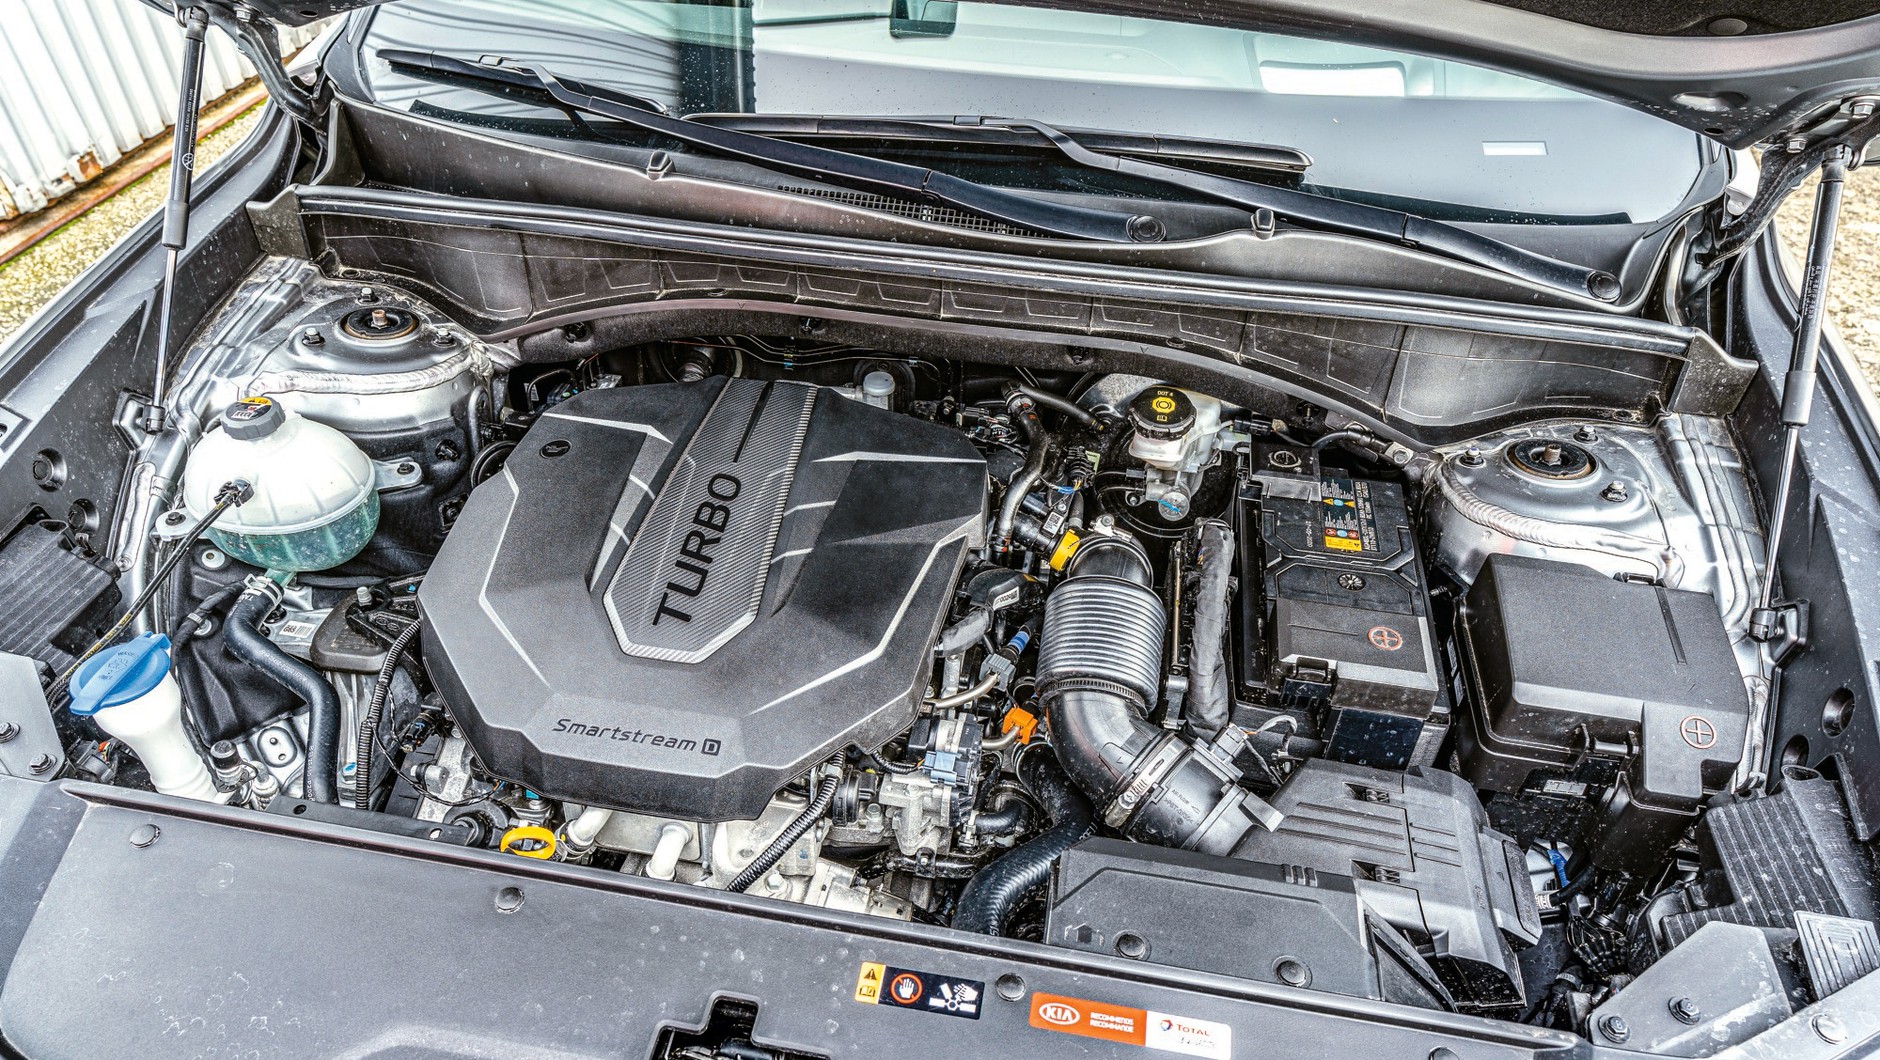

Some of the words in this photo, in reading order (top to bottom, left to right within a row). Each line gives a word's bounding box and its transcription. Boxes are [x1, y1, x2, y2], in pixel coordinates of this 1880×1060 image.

[652, 473, 742, 626] TURBO
[552, 718, 697, 752] Smartstream
[1044, 1005, 1075, 1023] KIA
